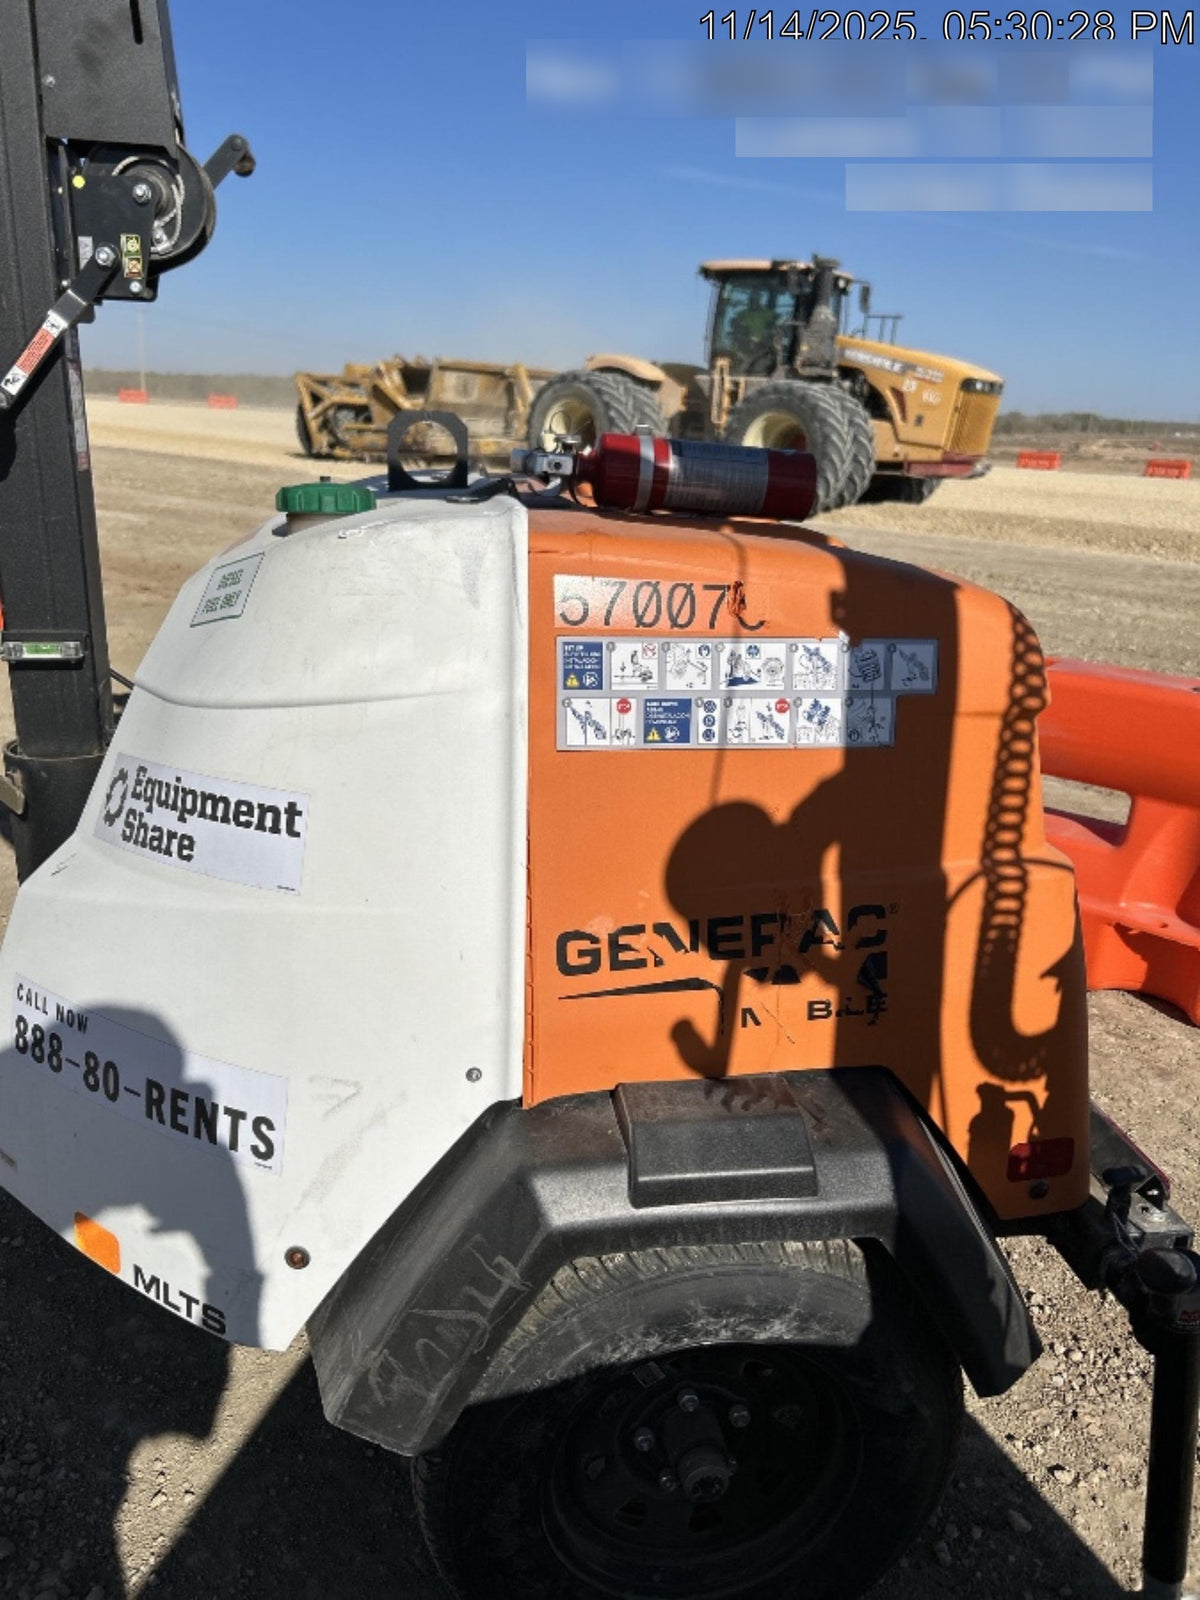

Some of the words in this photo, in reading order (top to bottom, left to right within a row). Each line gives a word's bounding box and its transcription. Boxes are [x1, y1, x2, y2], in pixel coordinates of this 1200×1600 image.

[121, 808, 196, 862] Share
[131, 765, 303, 838] Equipment
[16, 982, 49, 1015] CALL
[55, 1002, 89, 1034] NOW
[14, 1014, 276, 1161] 888-80-RENTS
[133, 1264, 227, 1335] MLTS
